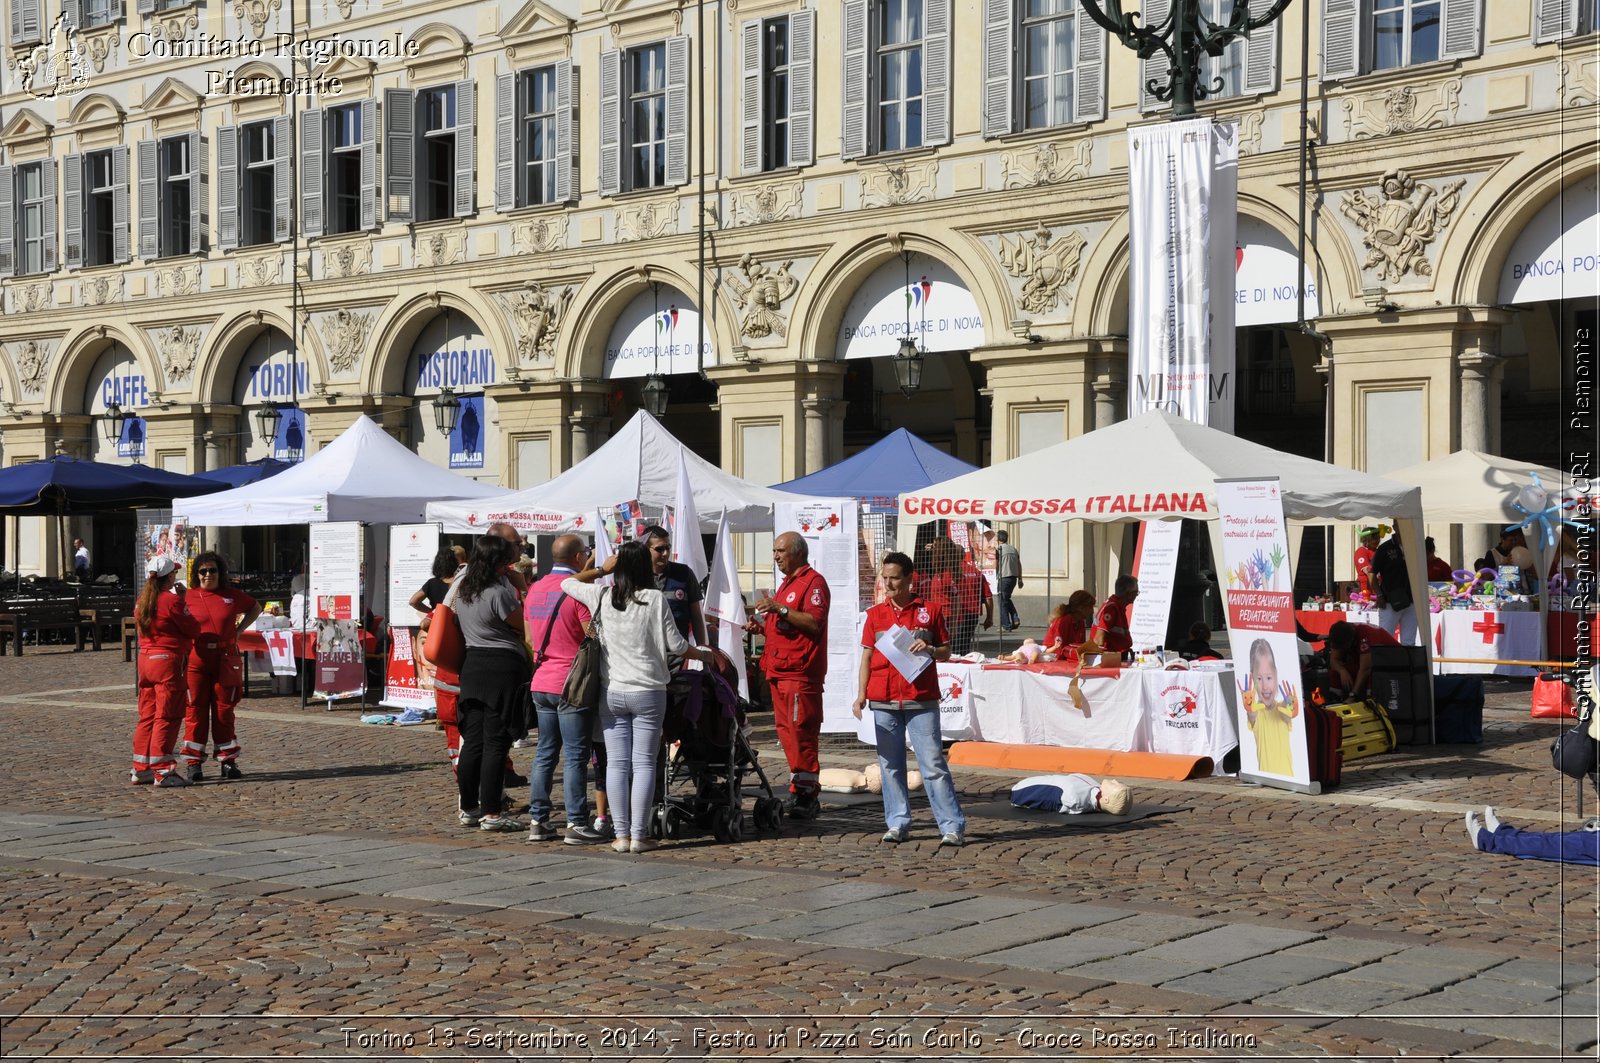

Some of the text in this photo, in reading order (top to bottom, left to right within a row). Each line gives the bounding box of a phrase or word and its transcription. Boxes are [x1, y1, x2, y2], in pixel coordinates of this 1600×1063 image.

[1513, 260, 1565, 279] BANCA
[1254, 287, 1266, 302] DI
[845, 316, 984, 339] BANCA POPOLARE DI NOVA
[608, 348, 634, 360] BANCA
[638, 344, 680, 358] POPOLARE
[684, 344, 693, 355] DI
[419, 349, 495, 388] RISTORANT
[103, 375, 149, 409] CAFFE
[904, 492, 1208, 516] CROCE ROSSA ITALIANA
[509, 512, 531, 522] ROSSA
[533, 513, 563, 522] ITALIANA
[1228, 593, 1290, 608] MANOVRE SALVAVITA
[1239, 609, 1279, 623] PEDIATRICHE
